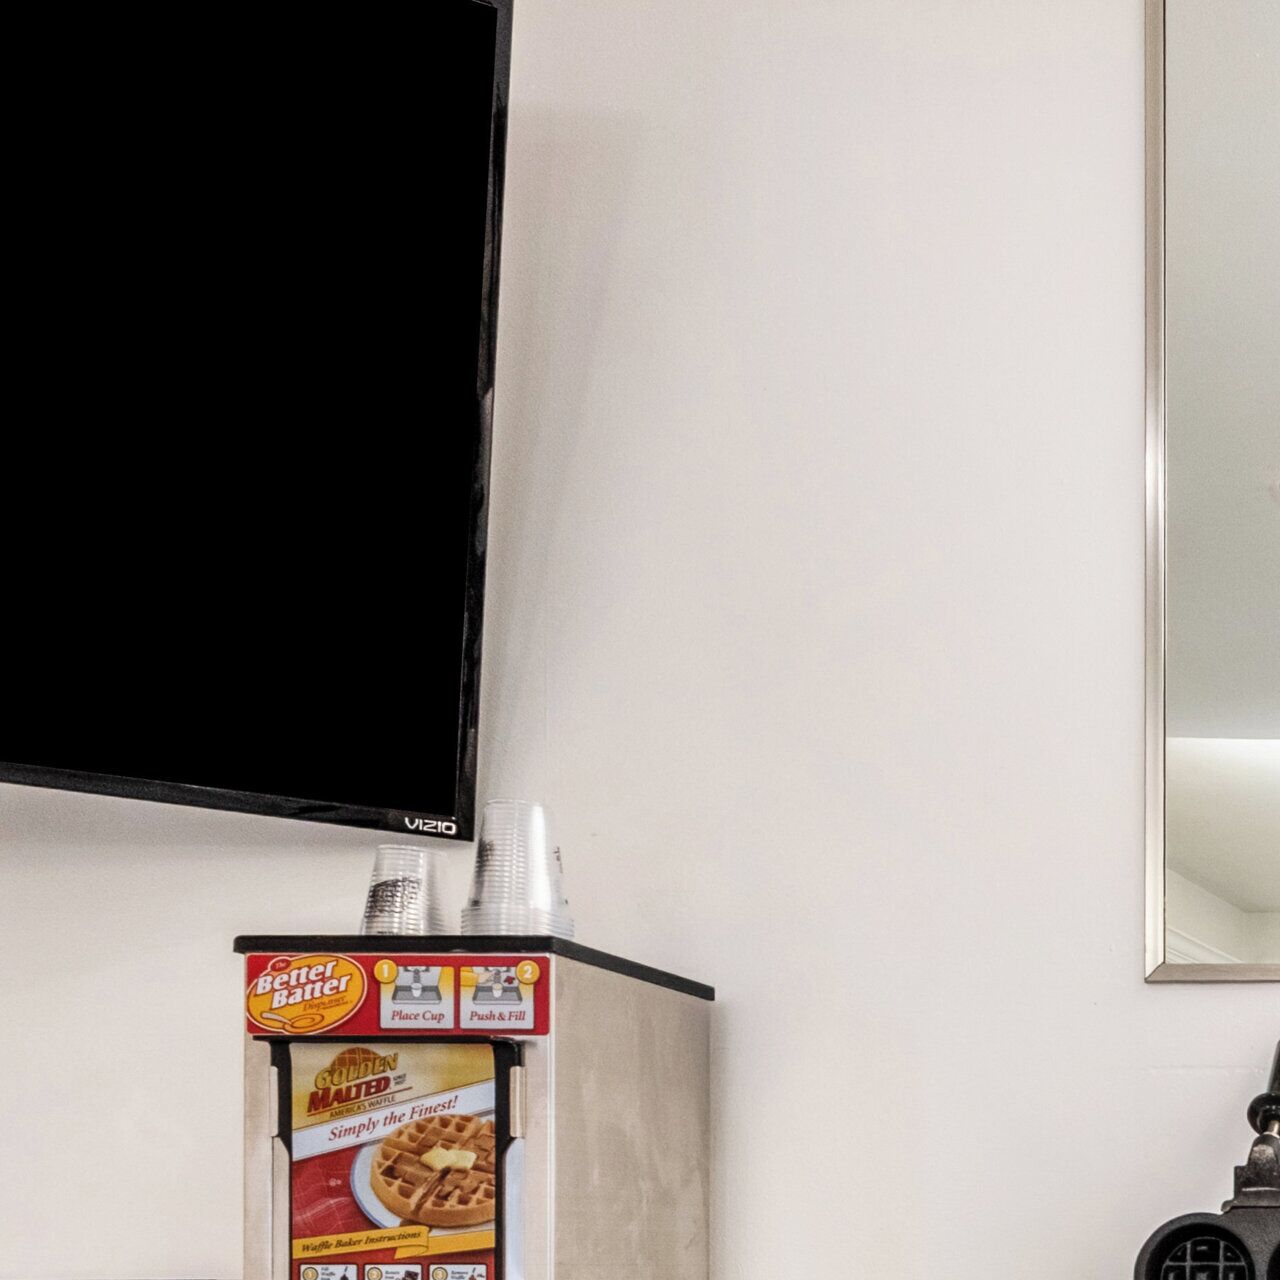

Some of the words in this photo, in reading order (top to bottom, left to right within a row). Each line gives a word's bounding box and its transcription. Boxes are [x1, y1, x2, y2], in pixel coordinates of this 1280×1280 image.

[405, 817, 457, 835] VIZIO
[256, 960, 338, 995] Better
[382, 964, 389, 977] 1
[524, 965, 532, 978] 2
[272, 975, 352, 1009] Batter
[391, 1010, 420, 1021] Place
[422, 1011, 445, 1023] Cup
[469, 1010, 496, 1021] Push
[497, 1011, 505, 1021] &
[507, 1010, 526, 1021] Fill
[315, 1053, 399, 1090] GOLDEN
[307, 1075, 391, 1113] MALTED
[328, 1119, 379, 1141] Simply
[383, 1110, 405, 1126] the
[409, 1095, 458, 1121] Finest!
[330, 1101, 367, 1119] AMERICA'S
[368, 1095, 396, 1109] WAFFLE
[302, 1240, 333, 1253] Waffle
[335, 1236, 363, 1248] Baker
[364, 1230, 421, 1246] Instructions
